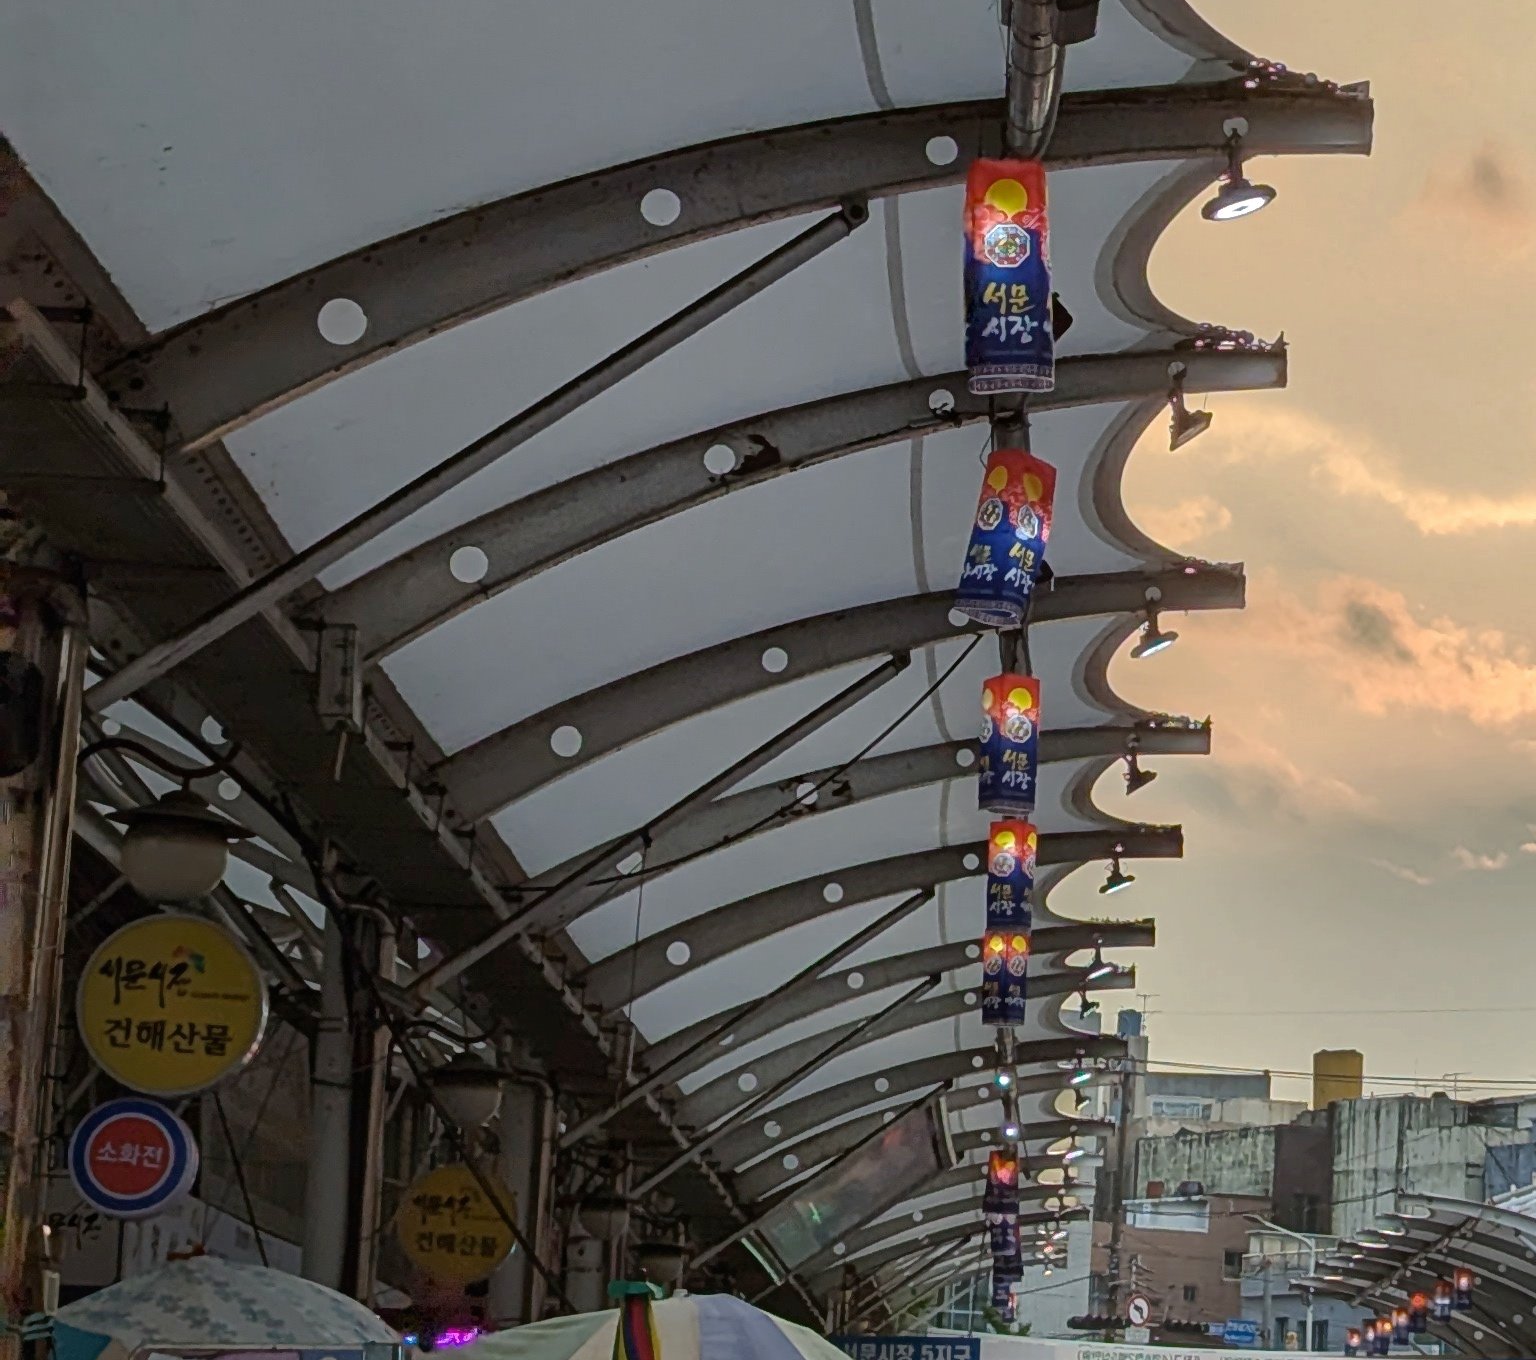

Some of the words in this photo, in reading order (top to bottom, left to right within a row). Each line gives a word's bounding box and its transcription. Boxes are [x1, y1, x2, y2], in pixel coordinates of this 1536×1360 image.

[982, 282, 1037, 314] 서문
[982, 314, 1039, 344] 시장
[1008, 541, 1036, 572] 서문
[1002, 748, 1031, 771] 서문
[1002, 769, 1032, 790] 시장
[103, 1017, 233, 1056] 건해산물
[96, 1142, 164, 1169] 소화전
